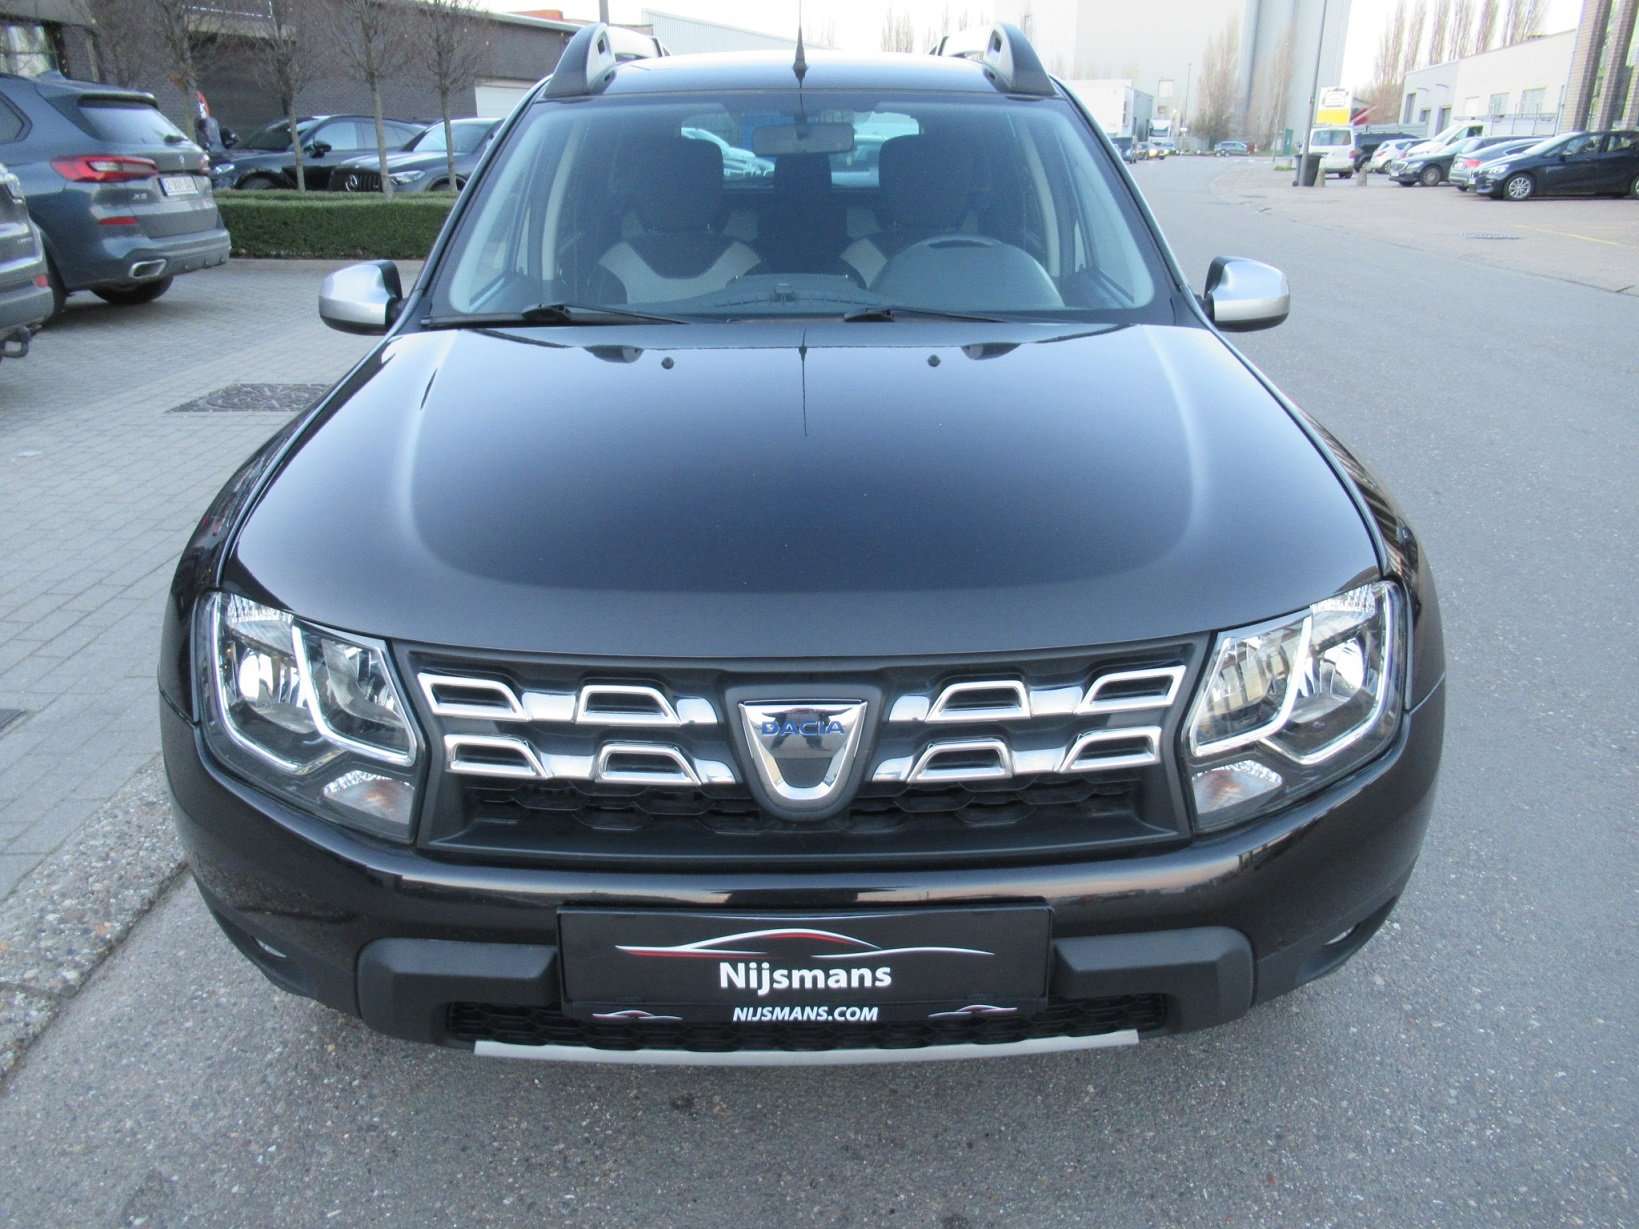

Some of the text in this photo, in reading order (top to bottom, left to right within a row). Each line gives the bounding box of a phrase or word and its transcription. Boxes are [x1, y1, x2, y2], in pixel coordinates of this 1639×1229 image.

[761, 721, 845, 737] DACIA
[719, 961, 892, 996] Nijsmans
[733, 1006, 879, 1023] NIJSMANS.COM
